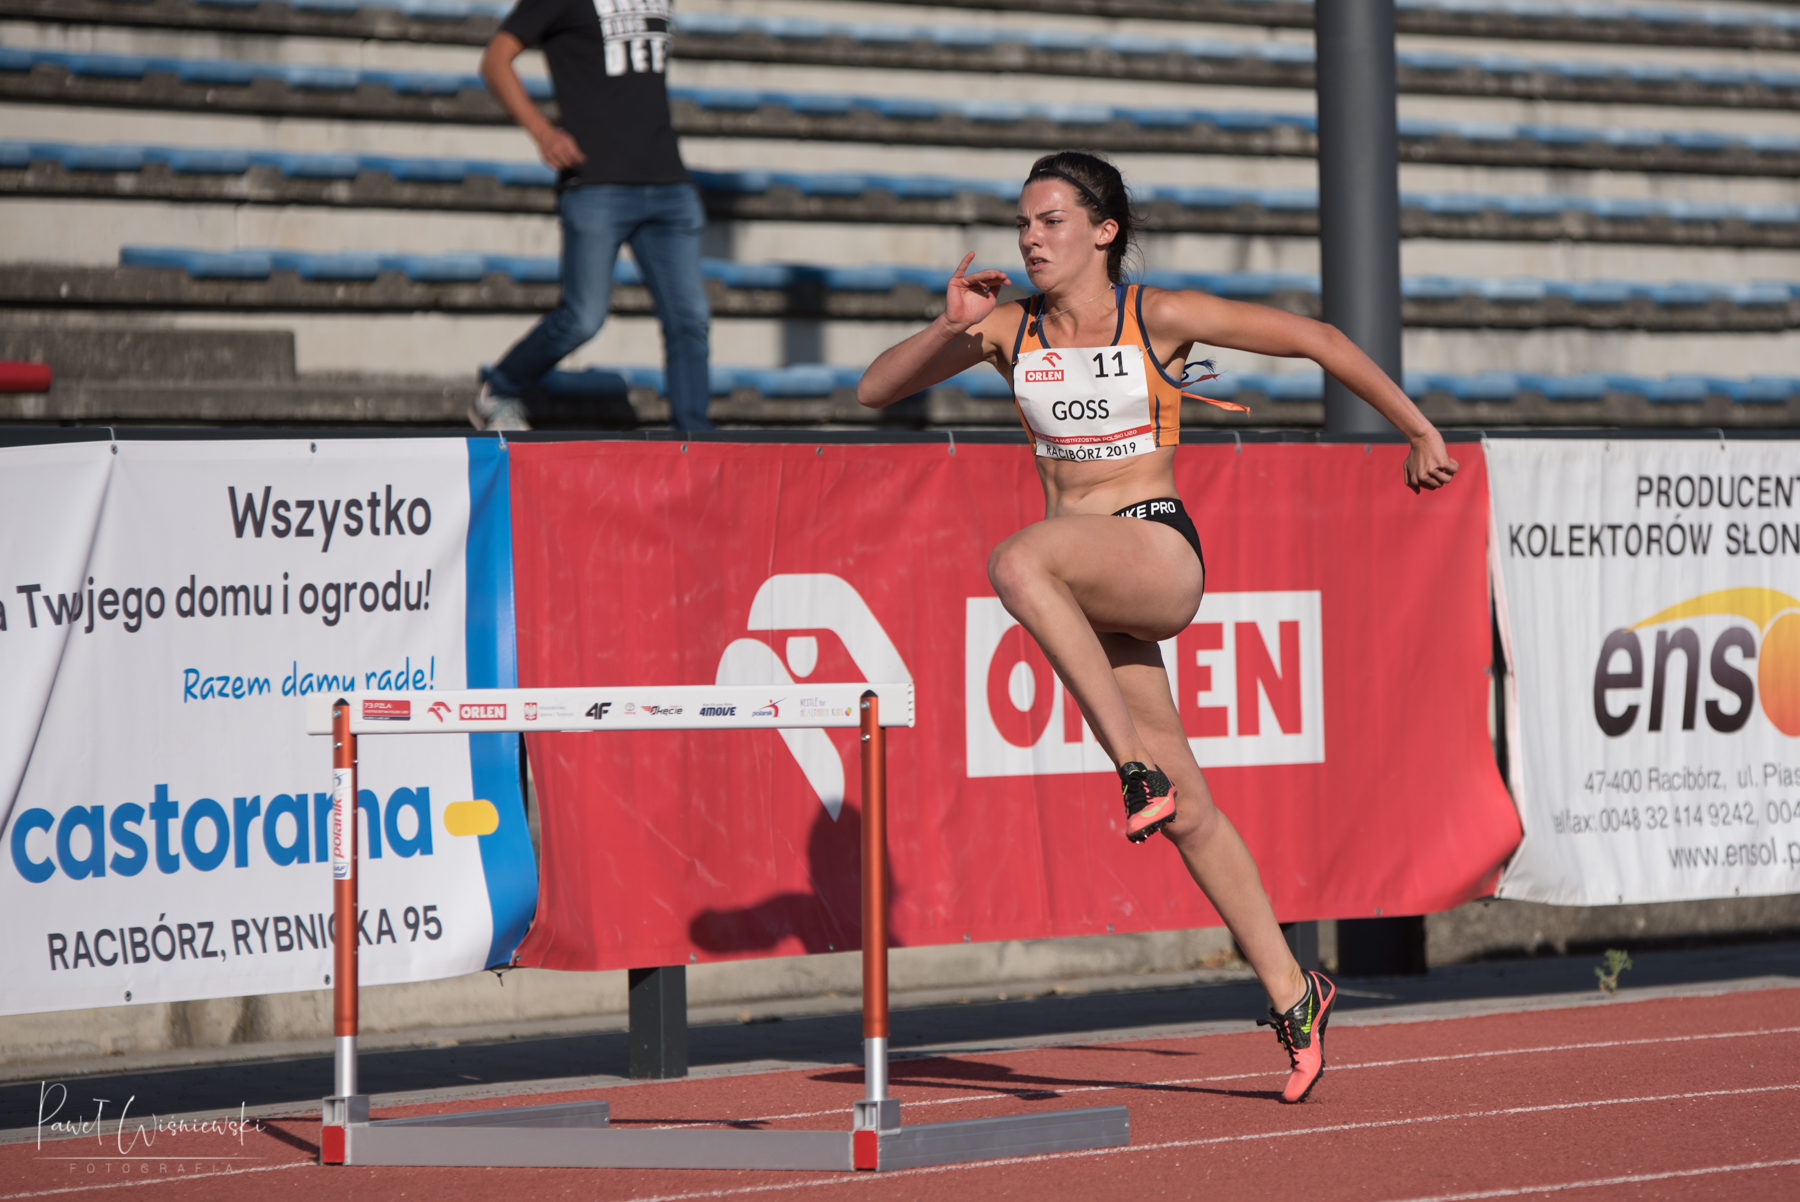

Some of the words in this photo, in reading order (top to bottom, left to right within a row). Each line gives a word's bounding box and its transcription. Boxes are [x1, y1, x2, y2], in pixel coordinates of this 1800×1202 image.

[1026, 371, 1063, 382] ORLEN
[1092, 351, 1129, 378] 11
[1051, 399, 1110, 421] GOSS
[1045, 443, 1102, 460] RACIBÓRZ
[1106, 442, 1137, 458] 2019
[1102, 432, 1124, 442] POLSKI
[1636, 475, 1800, 508] PRODUCEN
[227, 484, 432, 553] Wszystko
[1150, 501, 1176, 516] PRO
[1509, 513, 1713, 558] KOLEKTORÓW
[1726, 522, 1800, 557] SŁON
[16, 576, 165, 634] Twojego
[175, 574, 272, 619] domu
[282, 571, 289, 615] i
[299, 569, 432, 627] ogrodu!
[183, 667, 271, 704] Razem
[986, 620, 1303, 748] OEN
[461, 706, 504, 718] ORLEN
[585, 702, 612, 720] 4F
[752, 710, 773, 718] polanik
[1584, 769, 1642, 794] 47-400
[1648, 765, 1727, 793] Racibórz,
[1737, 764, 1759, 789] ul.
[333, 797, 345, 859] polanik
[1600, 806, 1641, 833] 0048
[1646, 805, 1669, 830] 32
[1674, 803, 1703, 828] 414
[1708, 800, 1760, 829] 9242,
[10, 783, 434, 884] castorama
[47, 912, 227, 971] RACIBÓRZ,
[403, 904, 443, 942] 95
